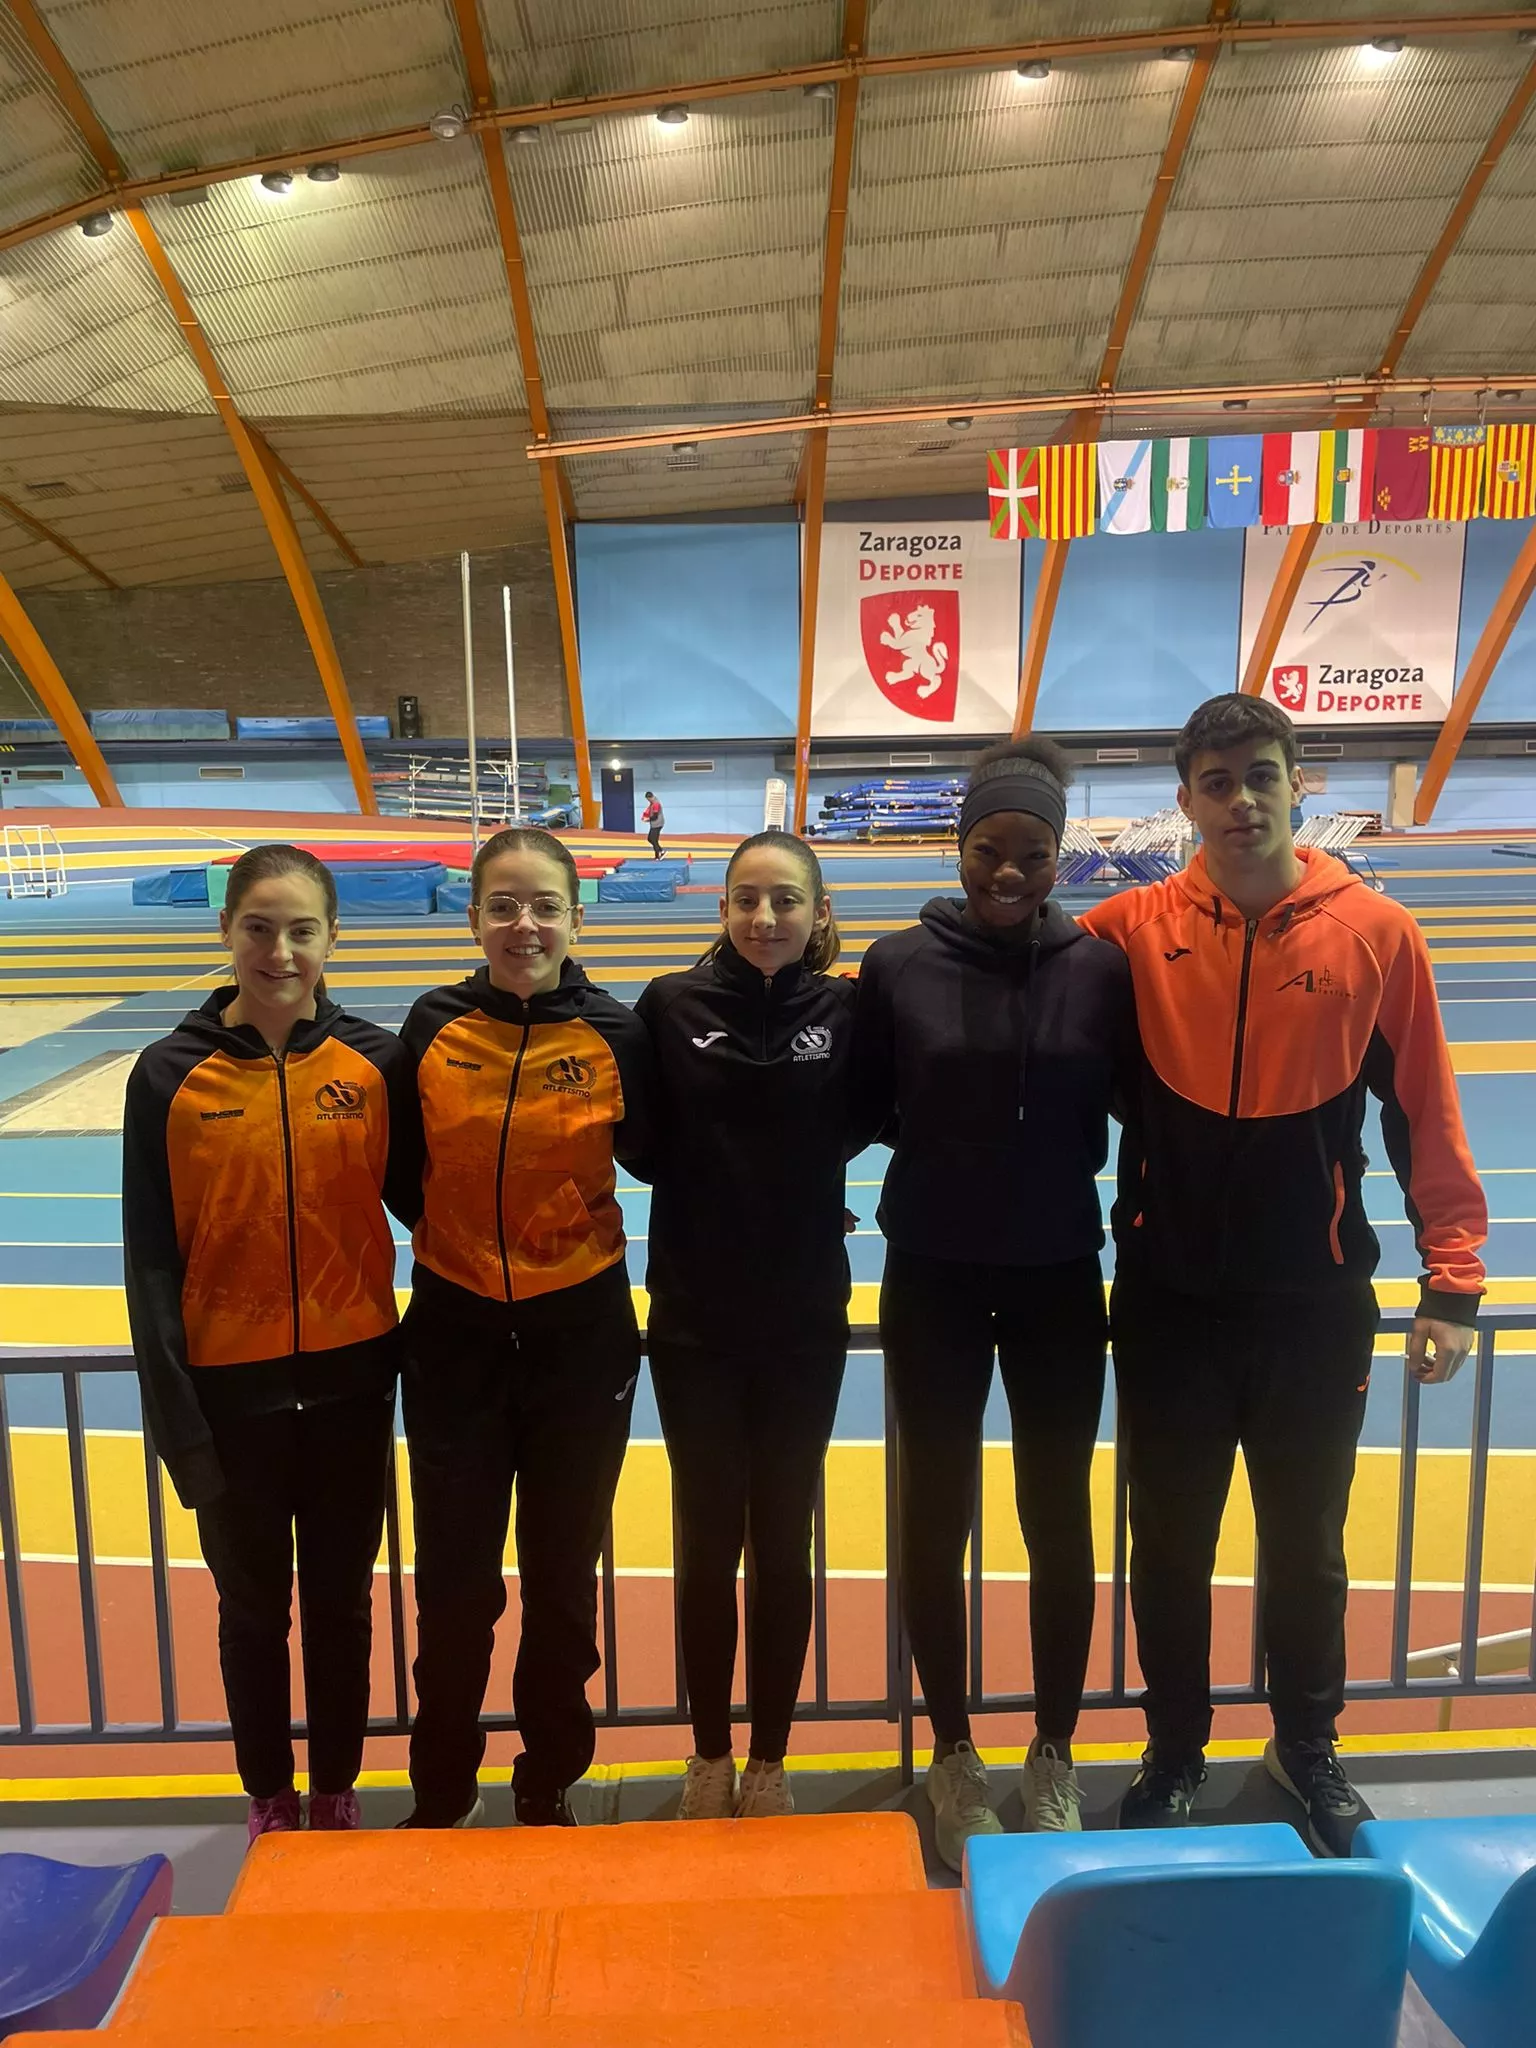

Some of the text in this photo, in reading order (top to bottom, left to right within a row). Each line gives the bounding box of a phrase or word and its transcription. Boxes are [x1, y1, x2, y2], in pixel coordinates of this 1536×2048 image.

[1341, 525, 1360, 535] DE
[1368, 518, 1452, 535] DEPORTES
[859, 531, 962, 557] Zaragoza
[859, 559, 963, 581] DEPORTE
[1318, 664, 1424, 690] Zaragoza
[1317, 690, 1422, 712] DEPORTE
[793, 1052, 831, 1062] ATLETISMO
[542, 1084, 591, 1098] ATLETISMO
[316, 1112, 365, 1121] ATLETISMO
